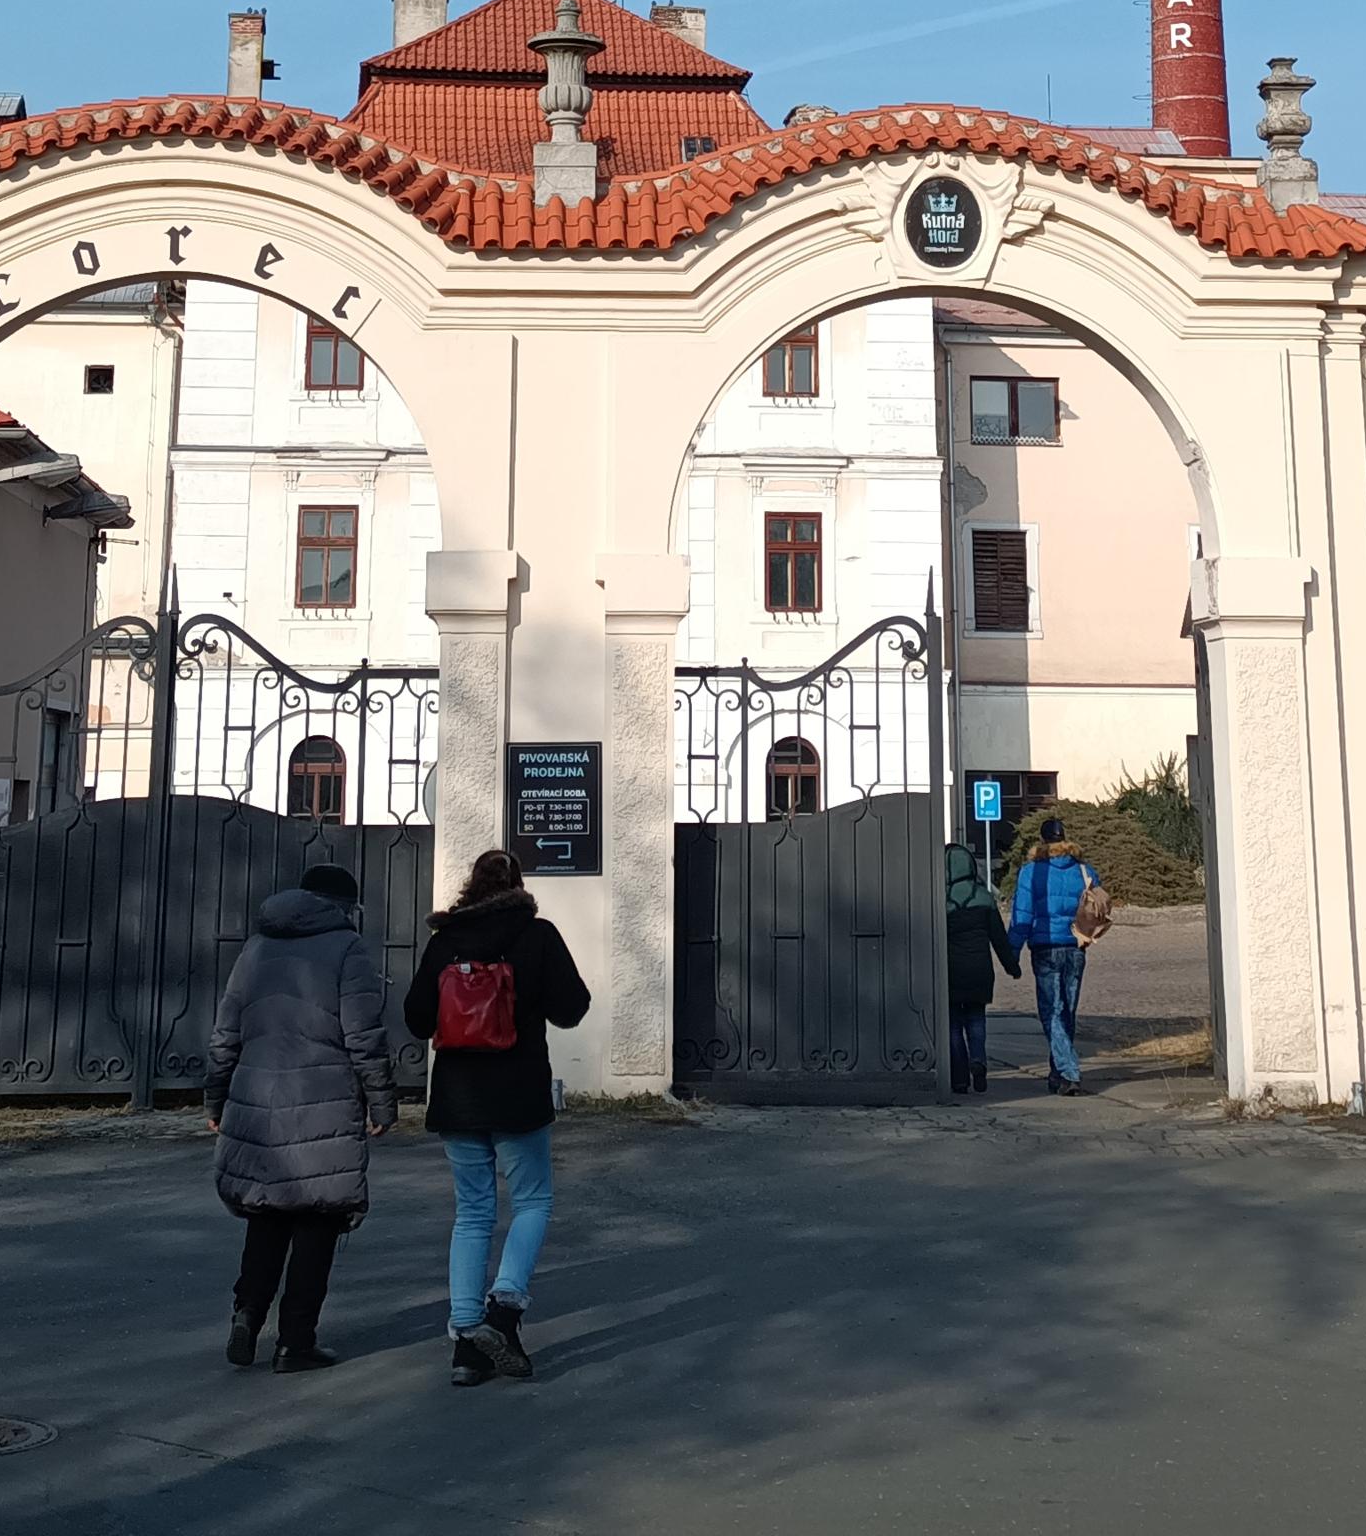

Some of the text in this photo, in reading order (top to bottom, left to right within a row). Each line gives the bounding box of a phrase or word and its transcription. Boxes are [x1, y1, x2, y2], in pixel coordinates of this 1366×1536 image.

[921, 212, 966, 229] Kutná
[928, 229, 960, 244] Hora
[519, 750, 590, 764] PIVOVARSKÁ
[523, 767, 585, 778] PRODEJNA
[521, 788, 587, 798] OTEVÍRACÍ DOBA
[980, 786, 995, 809] P
